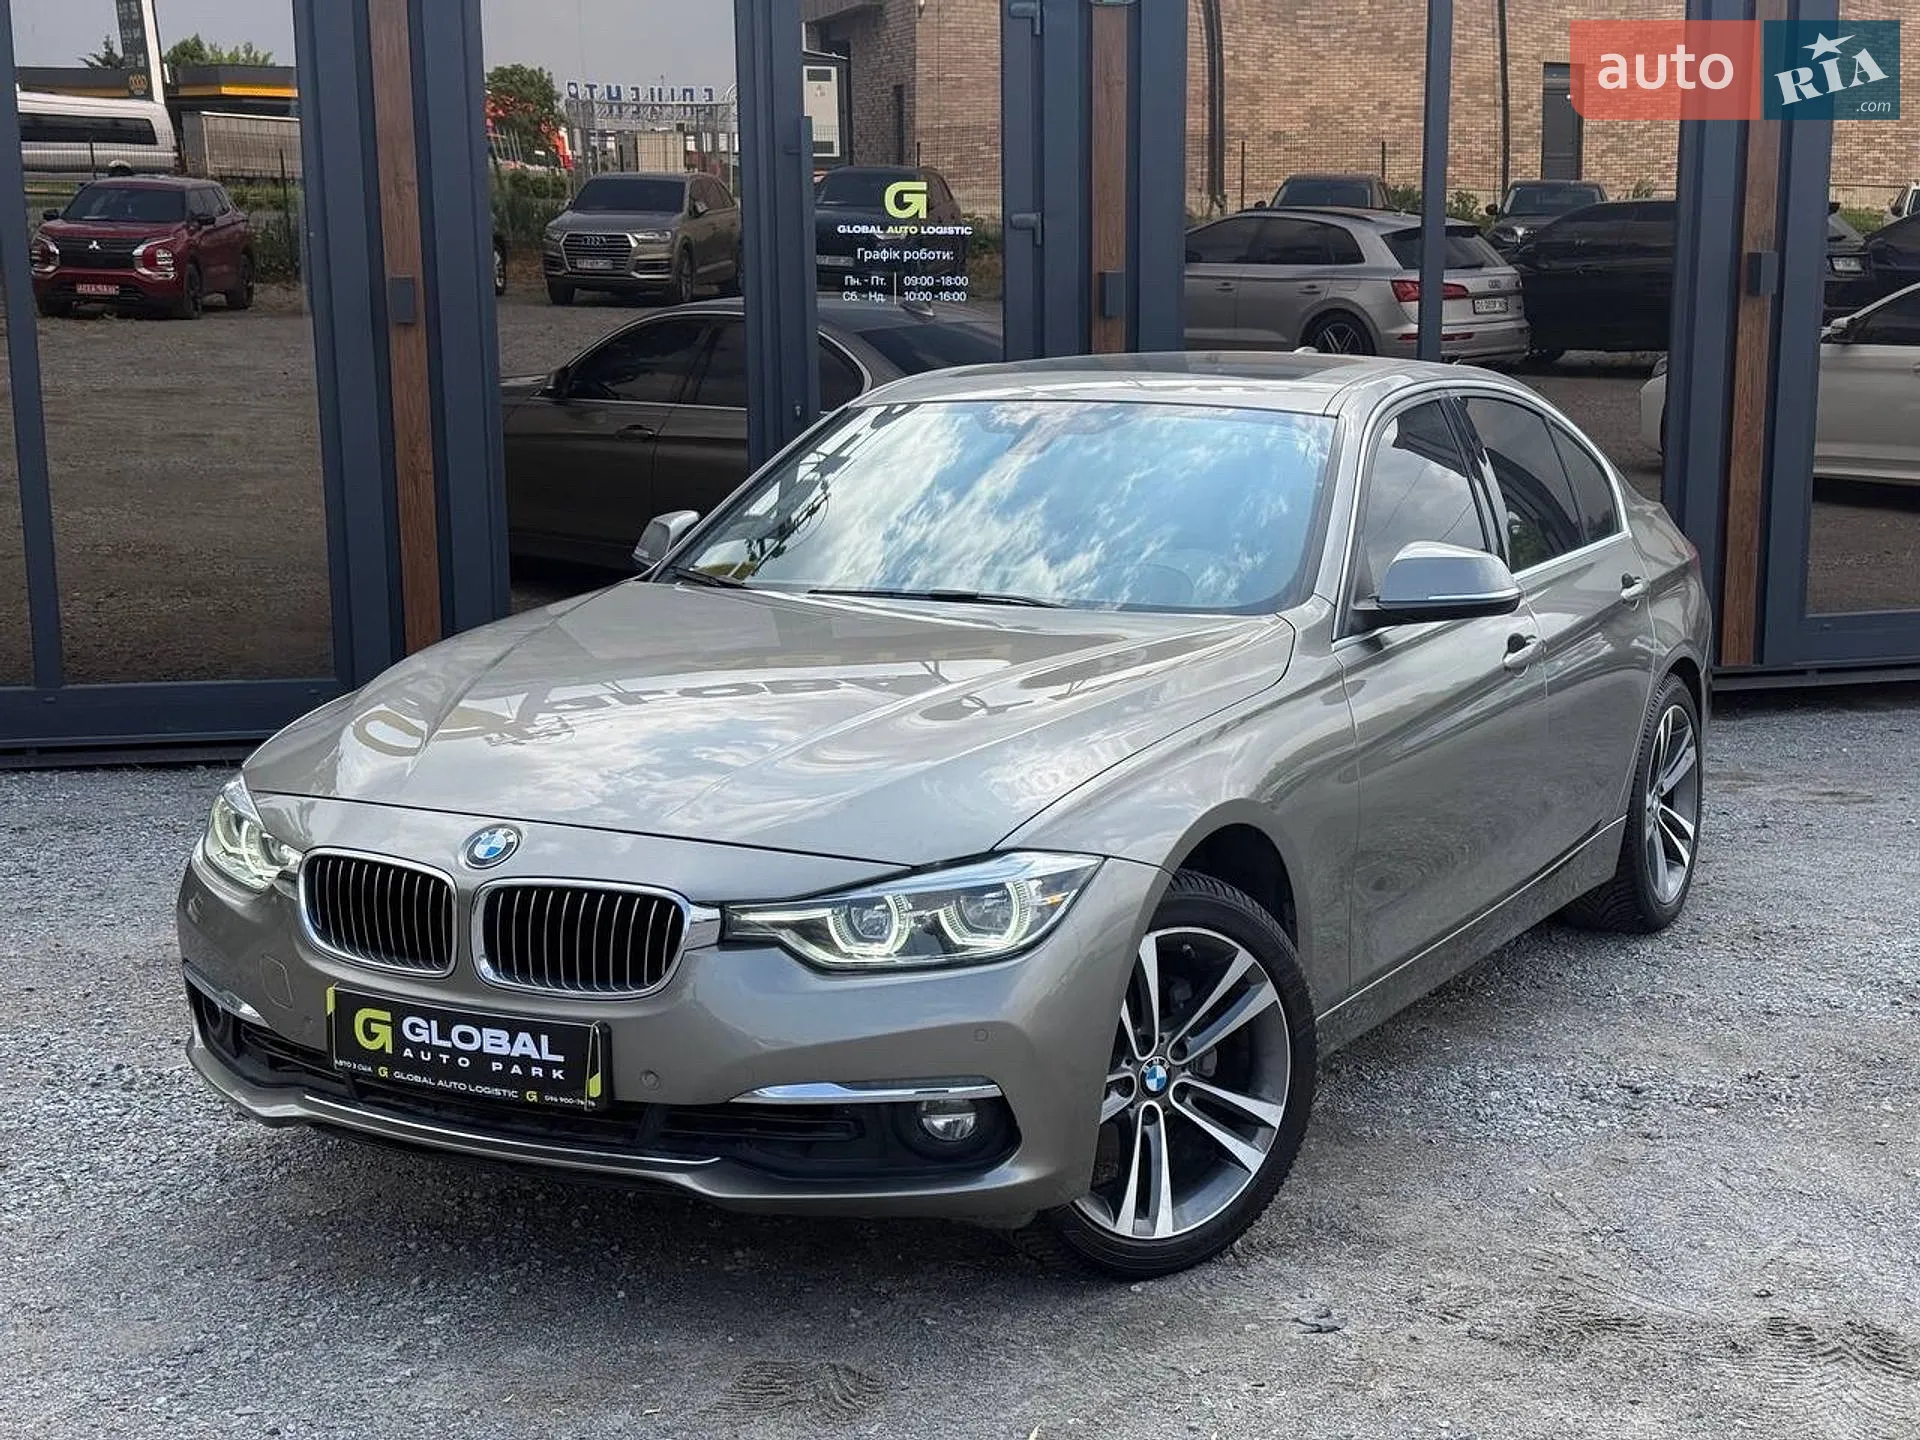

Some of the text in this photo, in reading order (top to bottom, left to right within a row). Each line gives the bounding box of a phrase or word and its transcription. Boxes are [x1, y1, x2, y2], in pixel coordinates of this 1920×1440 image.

[837, 225, 973, 235] GLOBAL AUTO LOGISTIC
[856, 247, 900, 262] Графік
[903, 247, 954, 262] роботи:
[844, 275, 862, 286] Пн.
[871, 275, 887, 286] Пт.
[354, 1008, 392, 1054] G
[401, 1016, 565, 1062] GLOBAL
[403, 1048, 565, 1080] AUTO PARK
[393, 1071, 436, 1086] GLOBAL
[437, 1080, 467, 1091] AUTO
[469, 1084, 519, 1098] LOGISTIC
